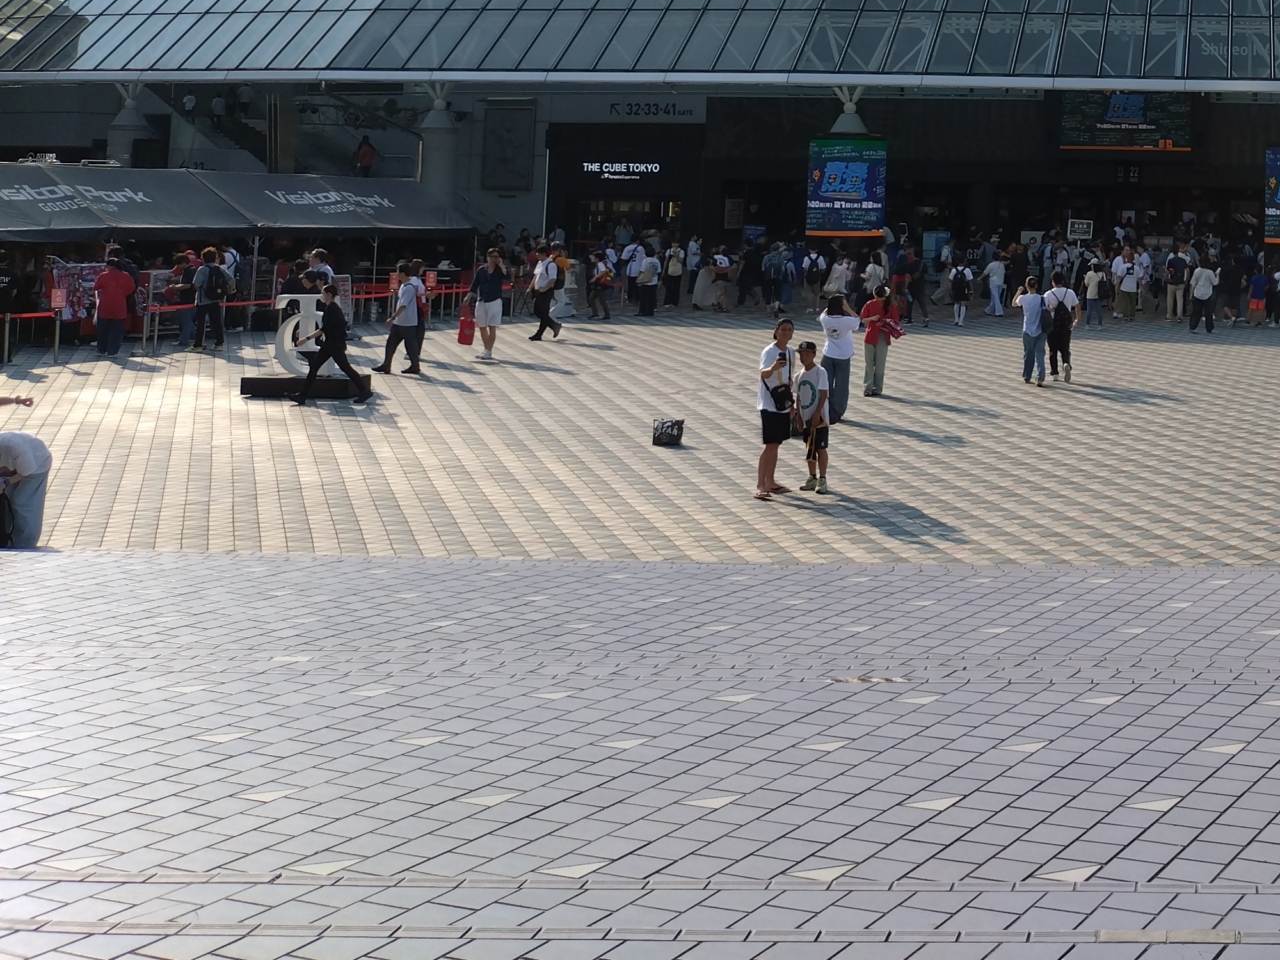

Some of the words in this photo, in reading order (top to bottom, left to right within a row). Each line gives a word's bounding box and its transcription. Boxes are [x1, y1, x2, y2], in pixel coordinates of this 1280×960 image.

[582, 162, 601, 172] THE
[602, 162, 628, 172] CUBE
[628, 163, 660, 173] TOKYO
[75, 184, 153, 203] Park
[264, 190, 343, 206] Visitor
[342, 191, 396, 208] Park
[38, 198, 87, 212] GOODS
[318, 202, 355, 214] GOODS
